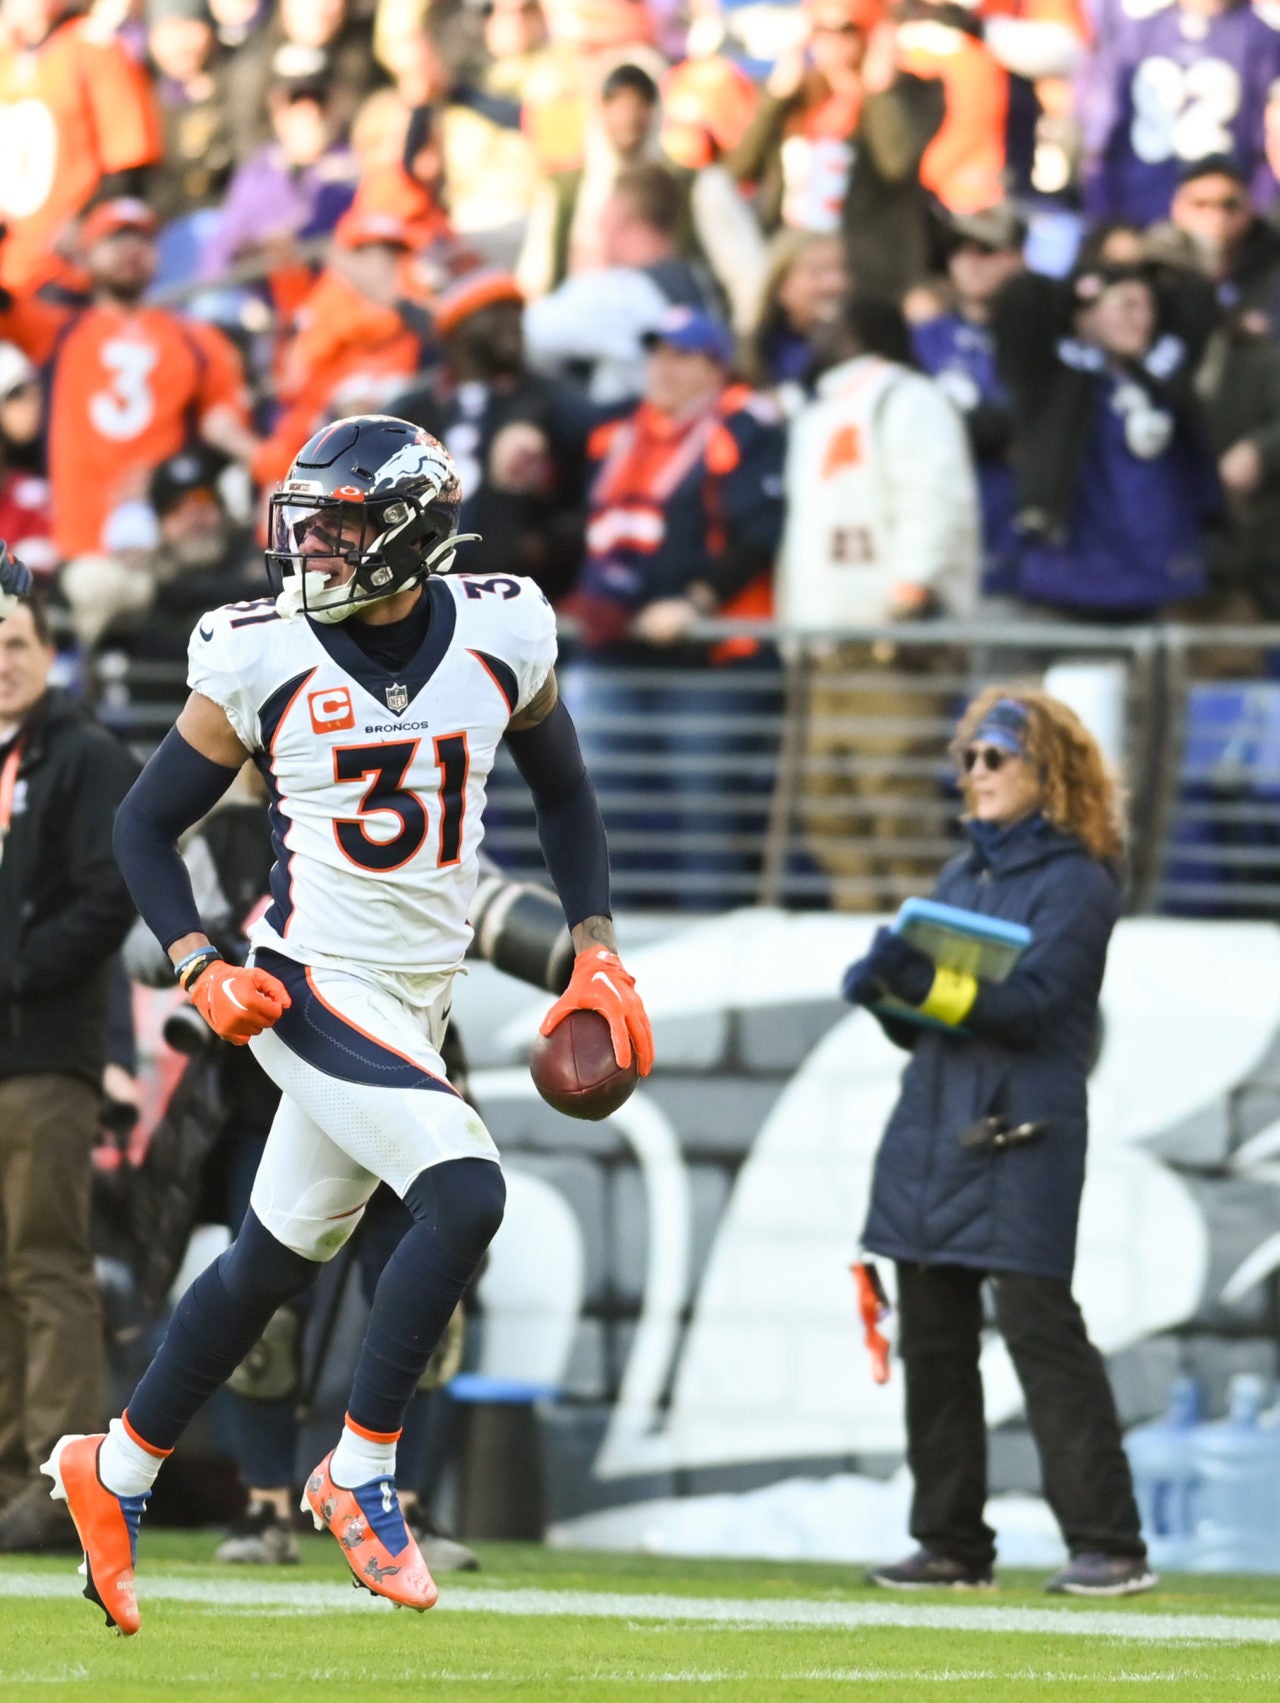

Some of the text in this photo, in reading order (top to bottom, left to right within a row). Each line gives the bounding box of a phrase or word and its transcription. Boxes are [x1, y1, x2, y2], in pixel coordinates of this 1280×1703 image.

[89, 340, 158, 441] 3
[311, 690, 350, 723] C
[365, 721, 429, 734] BRONCOS
[332, 731, 470, 873] 31
